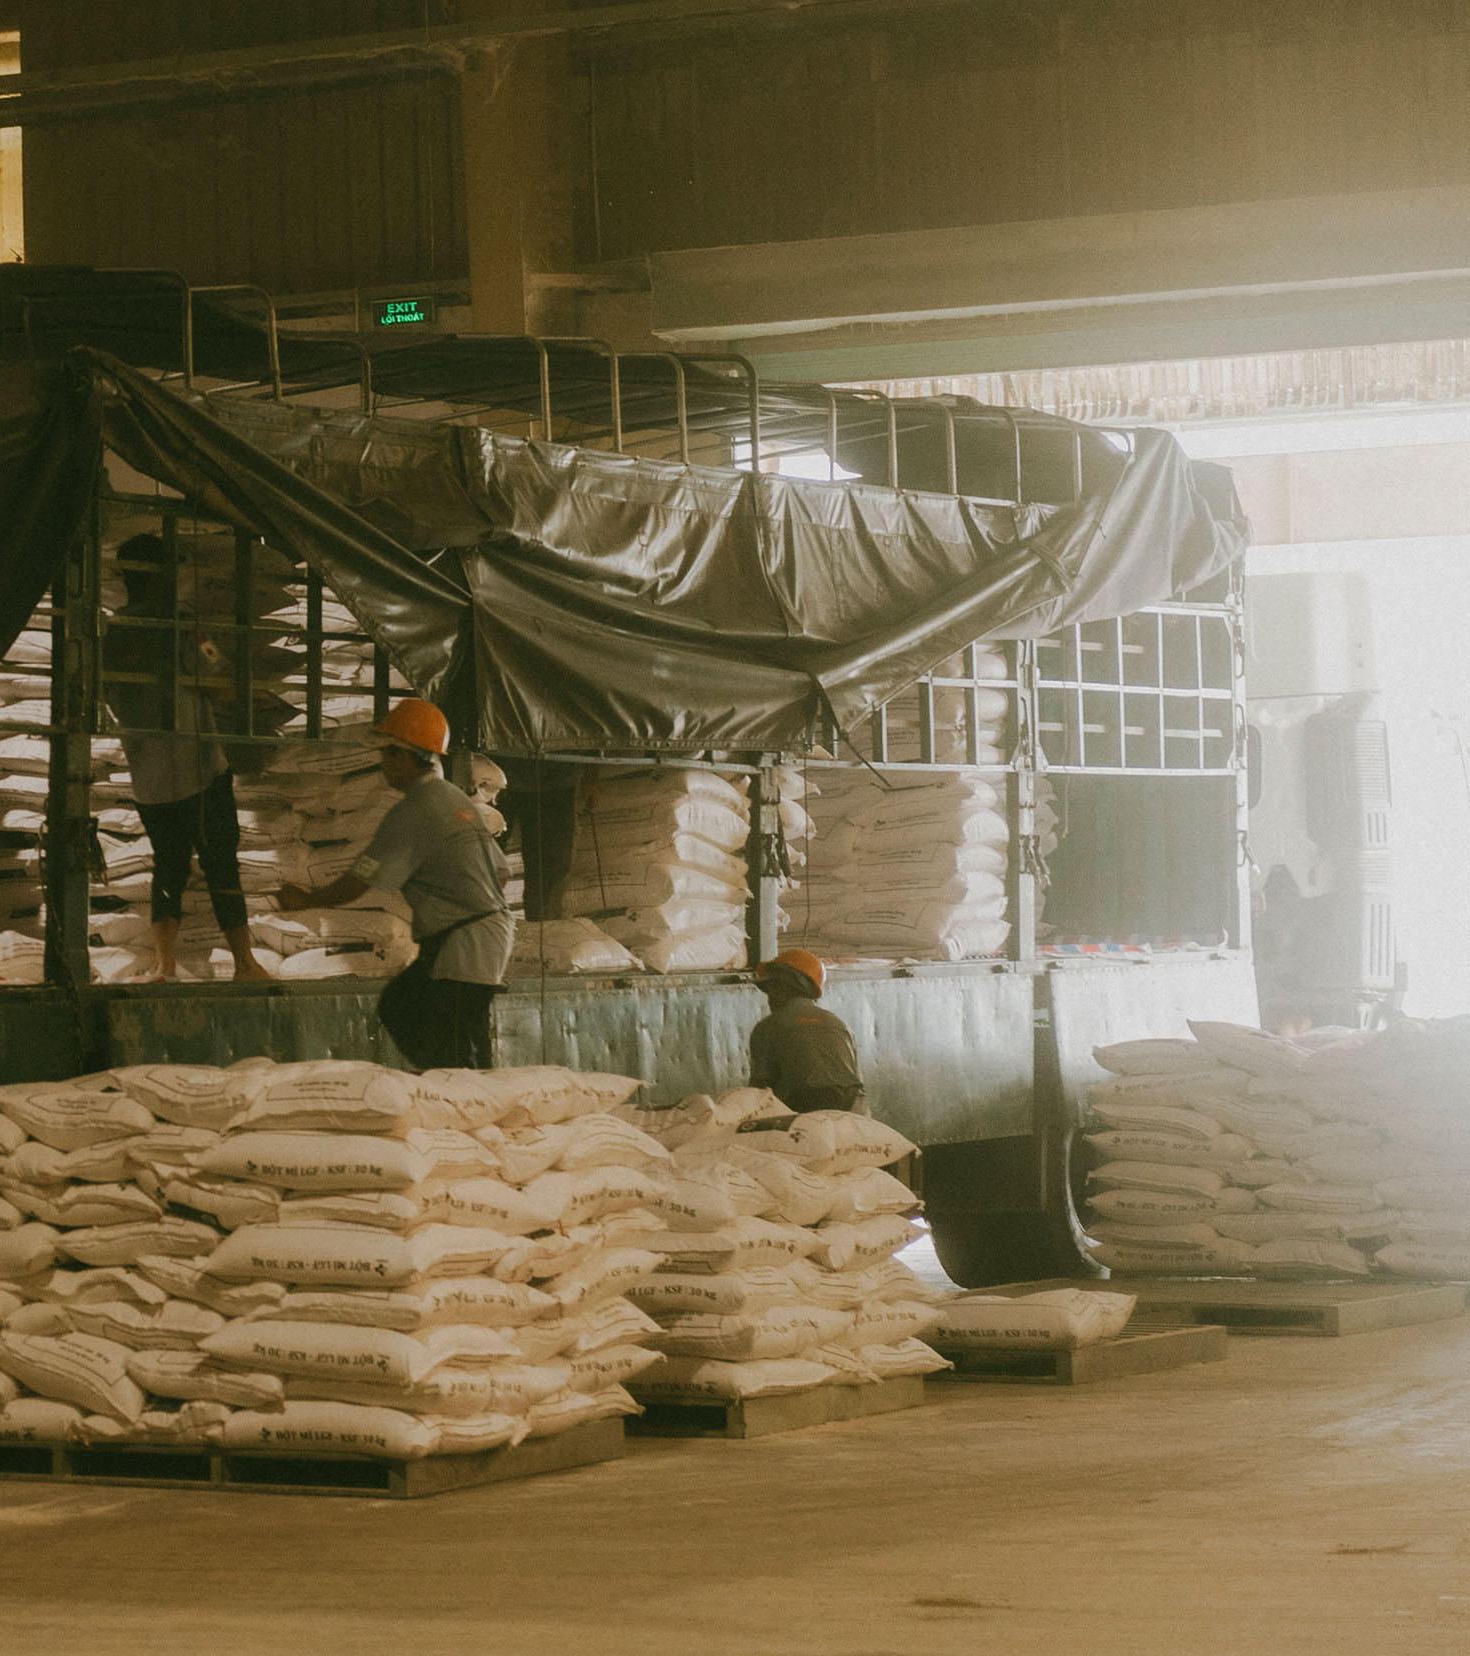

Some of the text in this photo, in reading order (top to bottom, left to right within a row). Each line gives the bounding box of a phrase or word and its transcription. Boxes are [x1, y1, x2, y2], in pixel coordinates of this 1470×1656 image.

[387, 301, 417, 313] EXIT
[683, 1206, 696, 1218] kg
[638, 1287, 655, 1297] LGF
[665, 1285, 682, 1295] KSF
[690, 1287, 702, 1296] 30
[704, 1289, 717, 1301] kg
